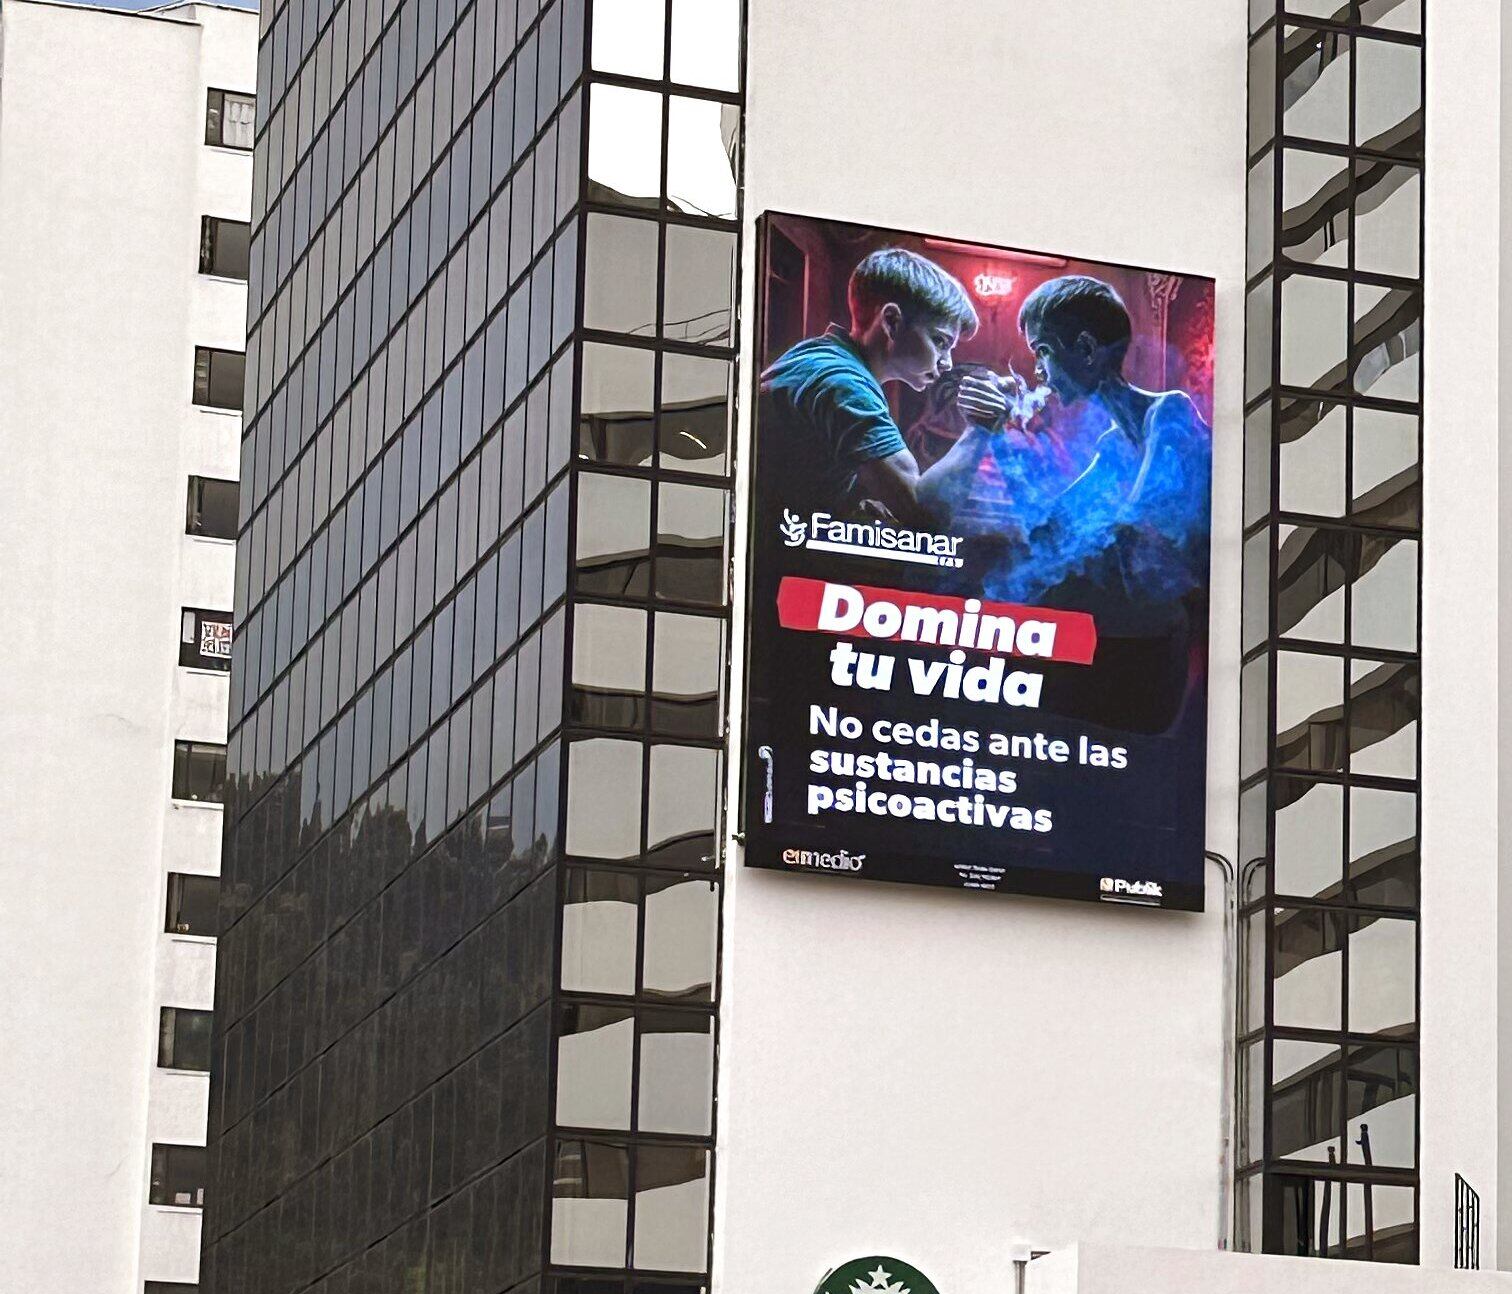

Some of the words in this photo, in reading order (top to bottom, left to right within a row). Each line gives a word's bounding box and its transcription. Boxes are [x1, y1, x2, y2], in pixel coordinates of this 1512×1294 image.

[811, 512, 964, 556] Famisanar
[818, 582, 1057, 658] Domina
[829, 642, 895, 692] tu
[908, 649, 1044, 708] vida
[809, 704, 863, 740] No
[872, 715, 980, 754] cedas
[988, 730, 1070, 764] ante
[1079, 736, 1128, 769] las
[809, 747, 1018, 794] sustancias
[807, 783, 1053, 833] psicoactivas
